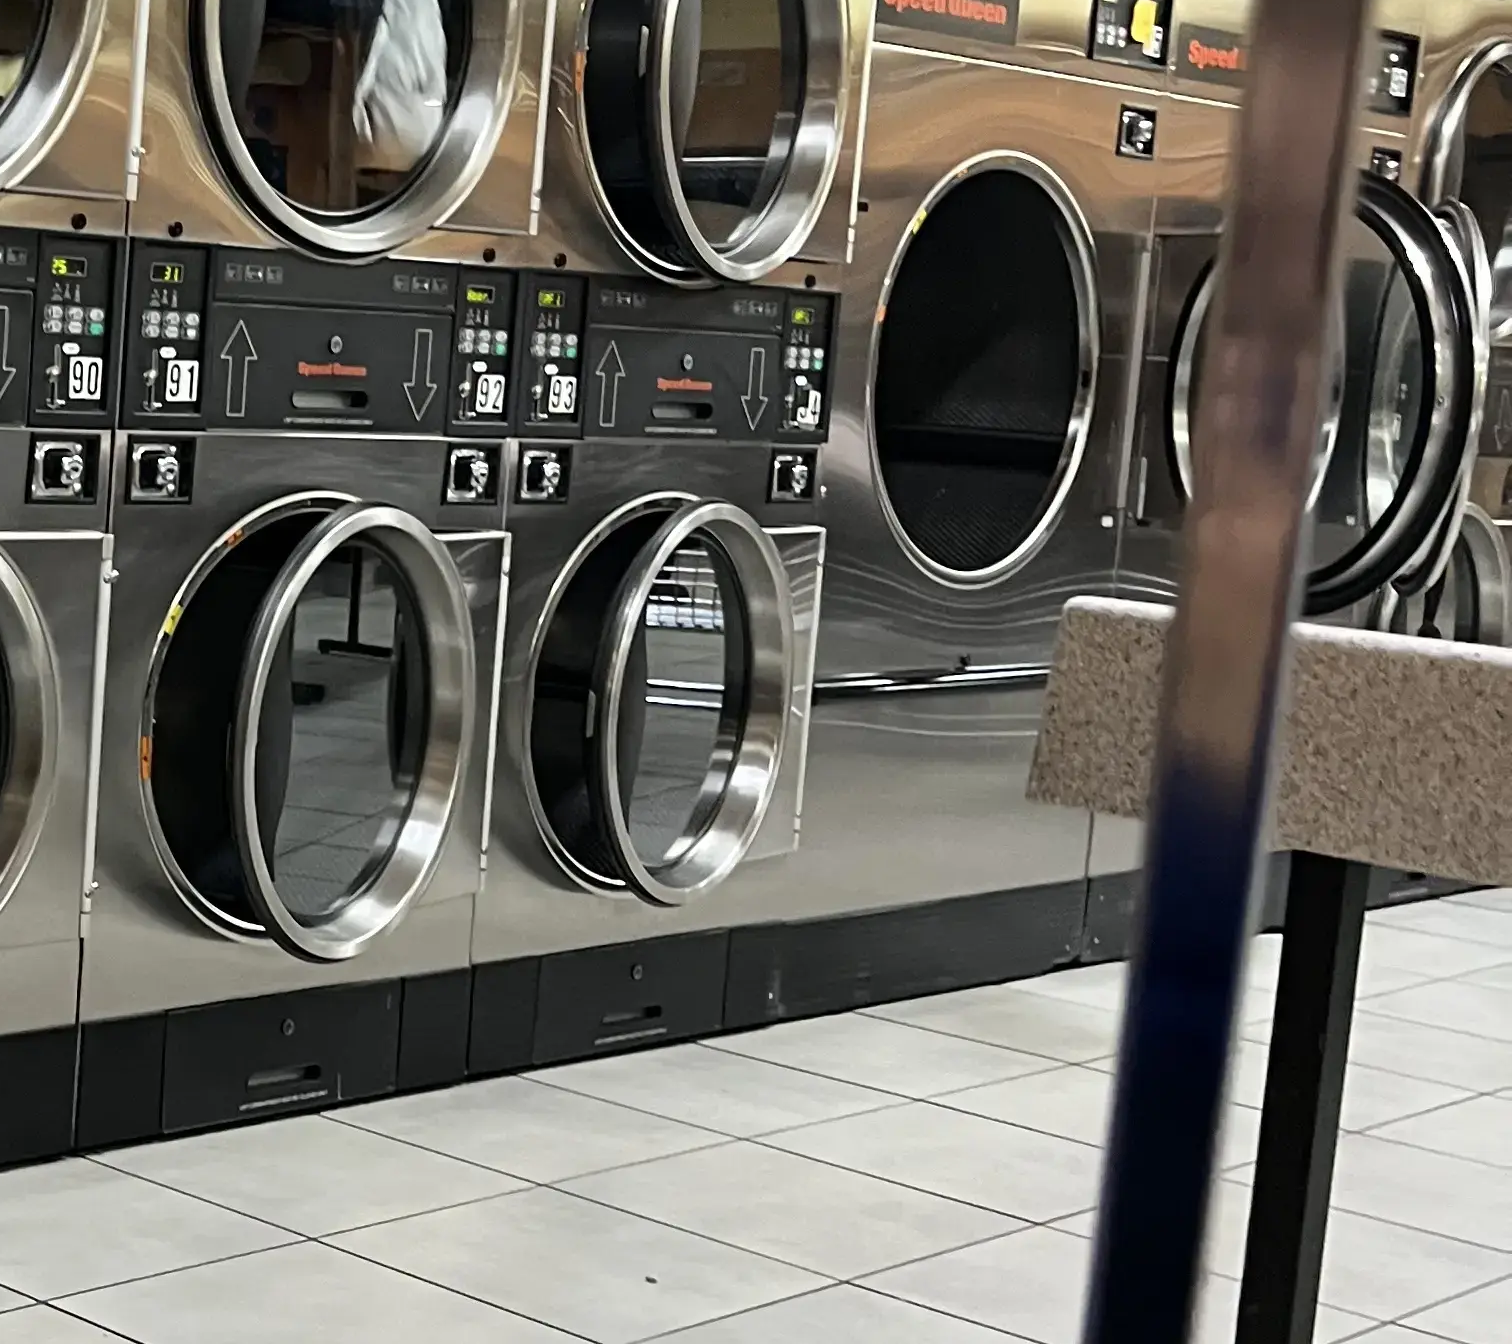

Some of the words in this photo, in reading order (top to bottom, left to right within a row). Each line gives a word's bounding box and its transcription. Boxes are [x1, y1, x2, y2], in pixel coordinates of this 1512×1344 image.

[1188, 39, 1239, 69] Speed
[72, 360, 99, 396] 90
[169, 363, 195, 400] 91
[478, 377, 503, 411] 92
[551, 379, 575, 411] 93
